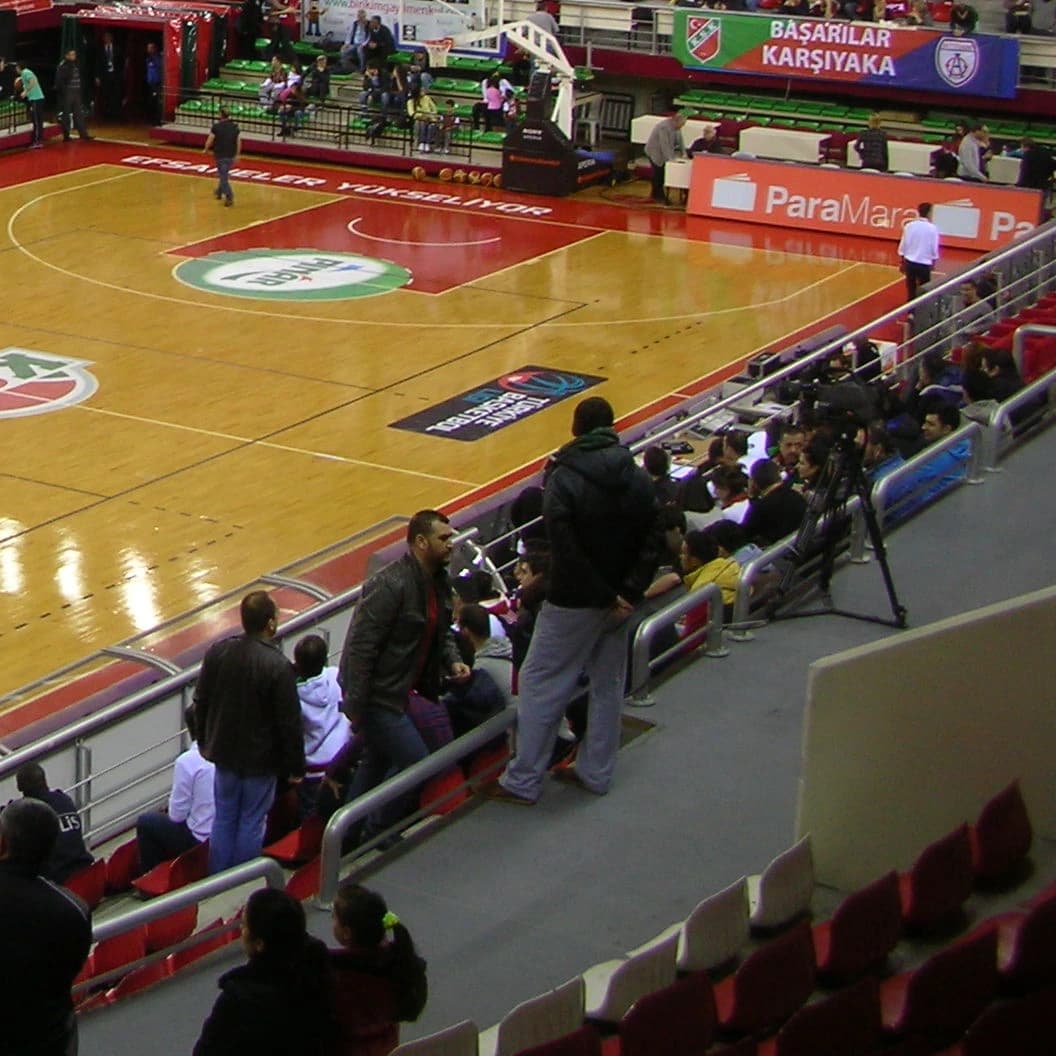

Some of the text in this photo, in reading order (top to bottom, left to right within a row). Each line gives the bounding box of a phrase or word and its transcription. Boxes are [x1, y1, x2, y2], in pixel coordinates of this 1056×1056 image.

[770, 19, 892, 48] BAŞARILAR
[762, 45, 897, 75] KARŞIYAKA
[247, 257, 345, 286] PINAR
[425, 391, 528, 433] BASKETBOL
